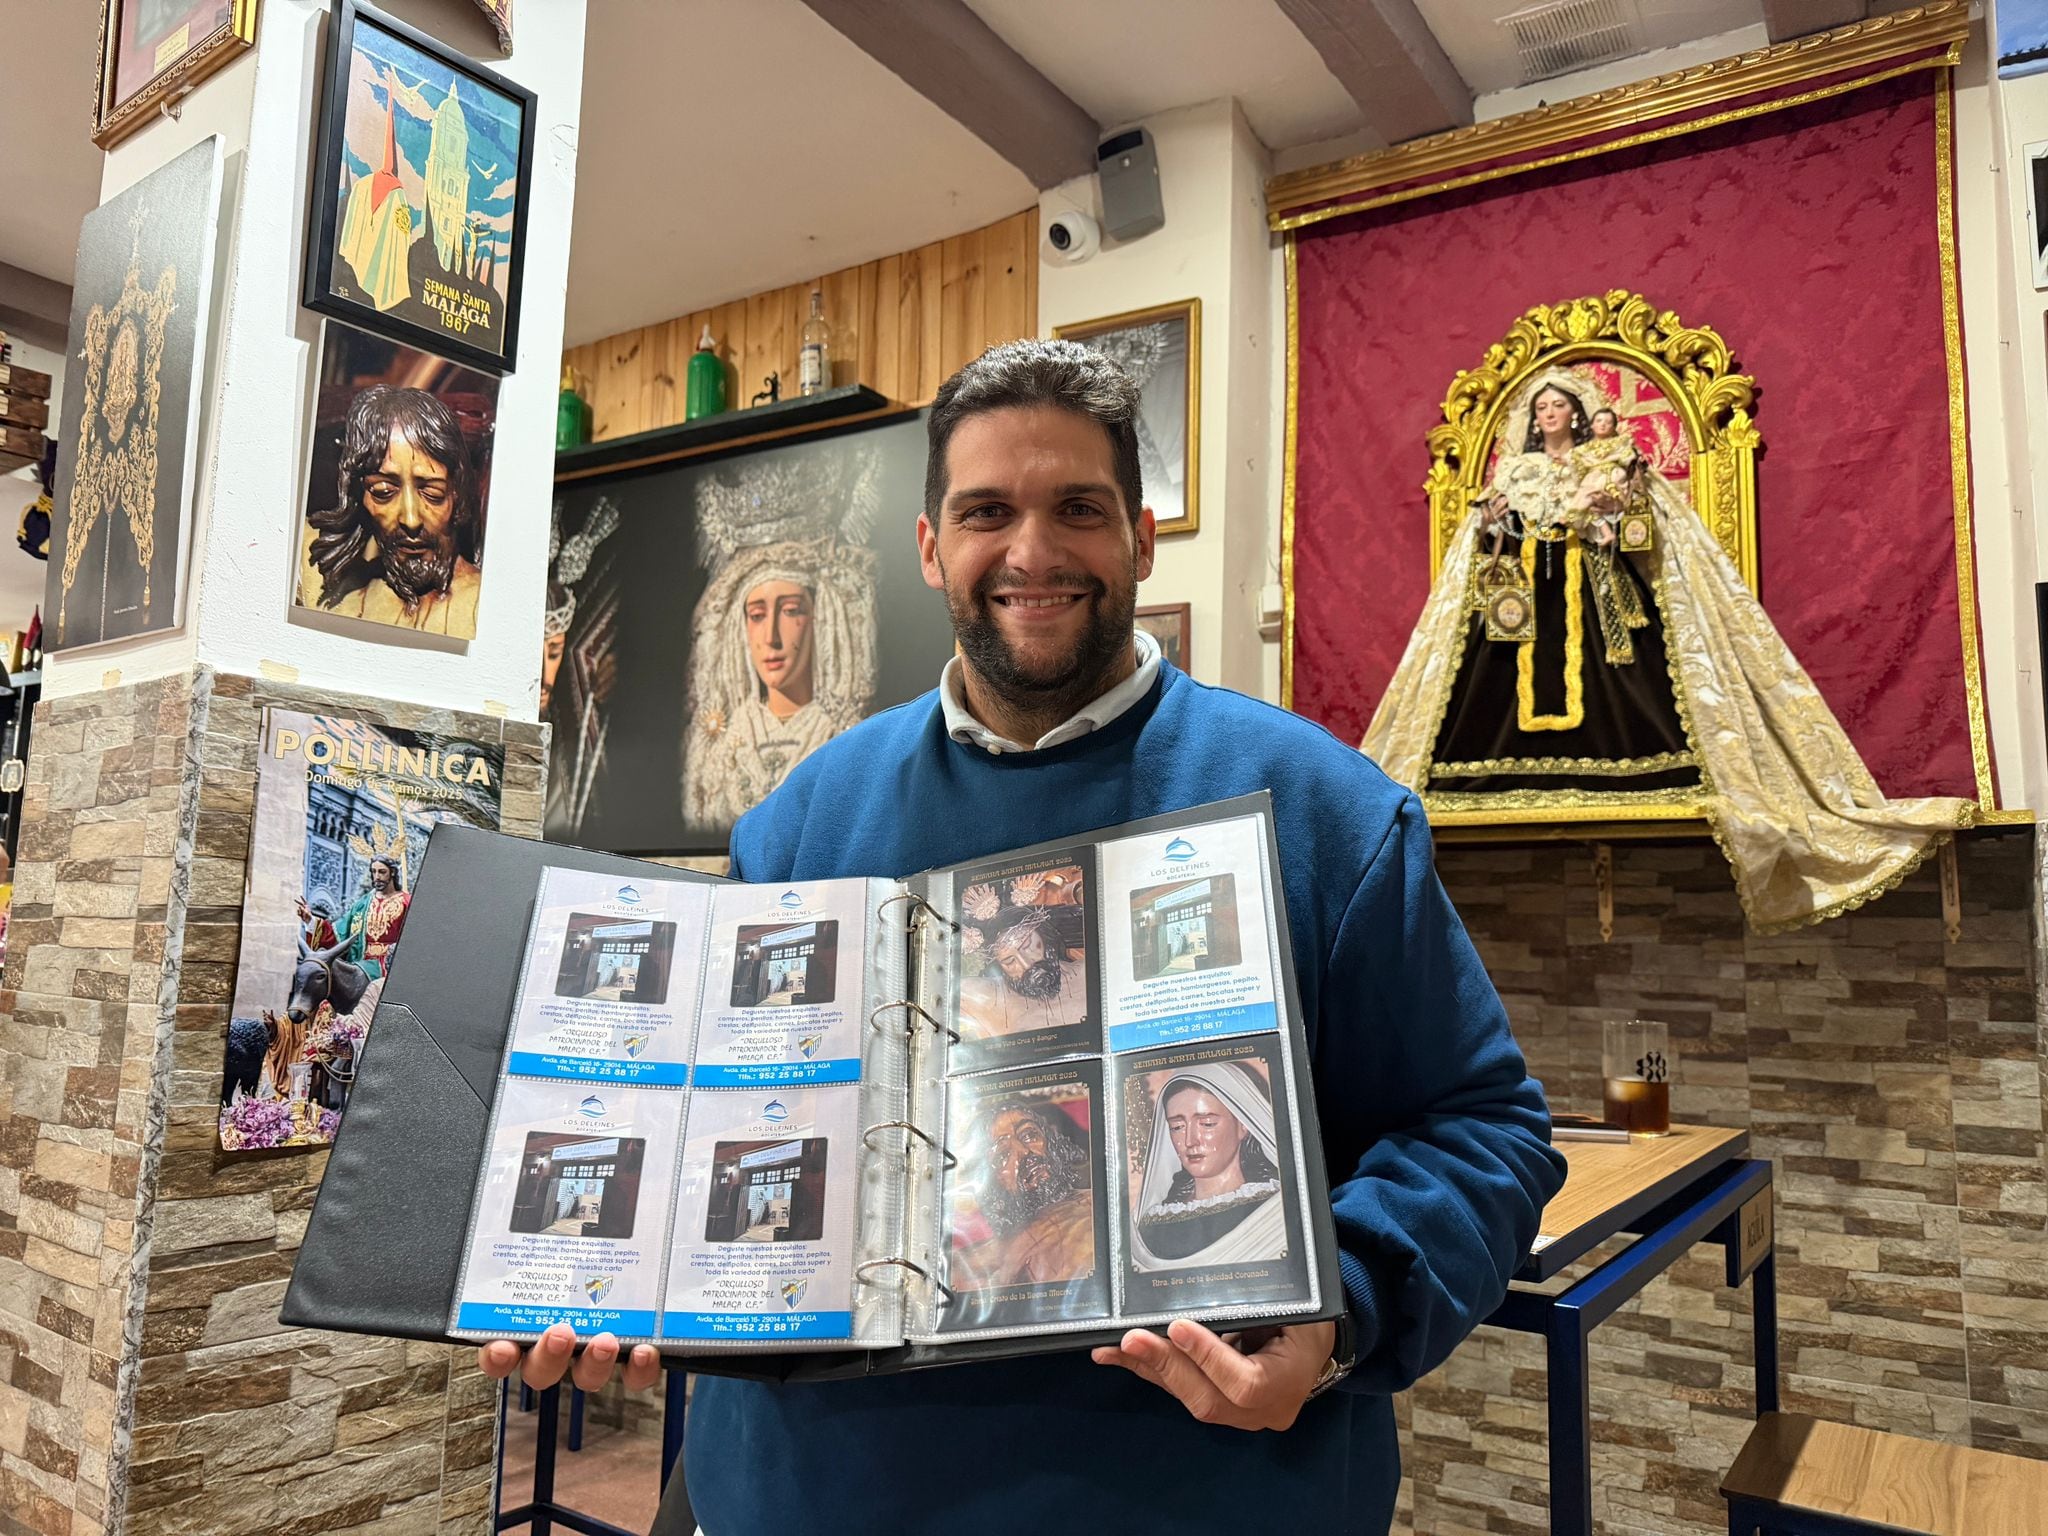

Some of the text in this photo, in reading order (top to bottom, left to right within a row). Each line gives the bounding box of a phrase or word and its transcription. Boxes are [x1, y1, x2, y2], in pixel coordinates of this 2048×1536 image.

[424, 278, 491, 315] SEMANA SANTA
[422, 289, 490, 329] MALAGA
[440, 311, 471, 335] 1967
[274, 728, 491, 786] POLLINICA
[304, 770, 363, 791] Domingo
[387, 780, 428, 796] Ramos
[432, 786, 463, 801] 2025
[1150, 861, 1210, 877] LOS DELFINES
[617, 905, 649, 913] DELFINES
[1174, 1025, 1189, 1034] 952
[1203, 1022, 1213, 1030] 88
[1133, 1057, 1167, 1069] SEMANA
[1168, 1053, 1196, 1064] SANTA
[1234, 1045, 1254, 1055] 2025
[579, 1066, 596, 1074] 952
[599, 1067, 611, 1076] 25
[614, 1069, 626, 1077] 88
[629, 1069, 639, 1077] 17
[778, 1071, 789, 1079] 25
[792, 1070, 804, 1078] 88
[807, 1069, 816, 1077] 17
[580, 1120, 615, 1128] DELFINES
[522, 1236, 616, 1249] Deguste nuestros exquisitos:
[717, 1245, 745, 1253] Deguste
[774, 1244, 807, 1252] exquisitos:
[534, 1261, 565, 1269] variedad
[502, 1280, 578, 1293] PATROCINADOR DEL
[702, 1290, 775, 1299] PATROCINADOR DEL
[524, 1308, 550, 1316] Barceló
[562, 1310, 582, 1318] 29014
[588, 1311, 621, 1319] MÁLAGA
[725, 1315, 750, 1323] Barceló
[786, 1314, 817, 1322] MÁLAGA
[535, 1316, 554, 1325] 952
[574, 1317, 588, 1327] 88
[592, 1319, 603, 1327] 17
[736, 1323, 755, 1332] 952
[758, 1323, 770, 1331] 25
[773, 1323, 786, 1331] 88
[790, 1323, 801, 1331] 17
